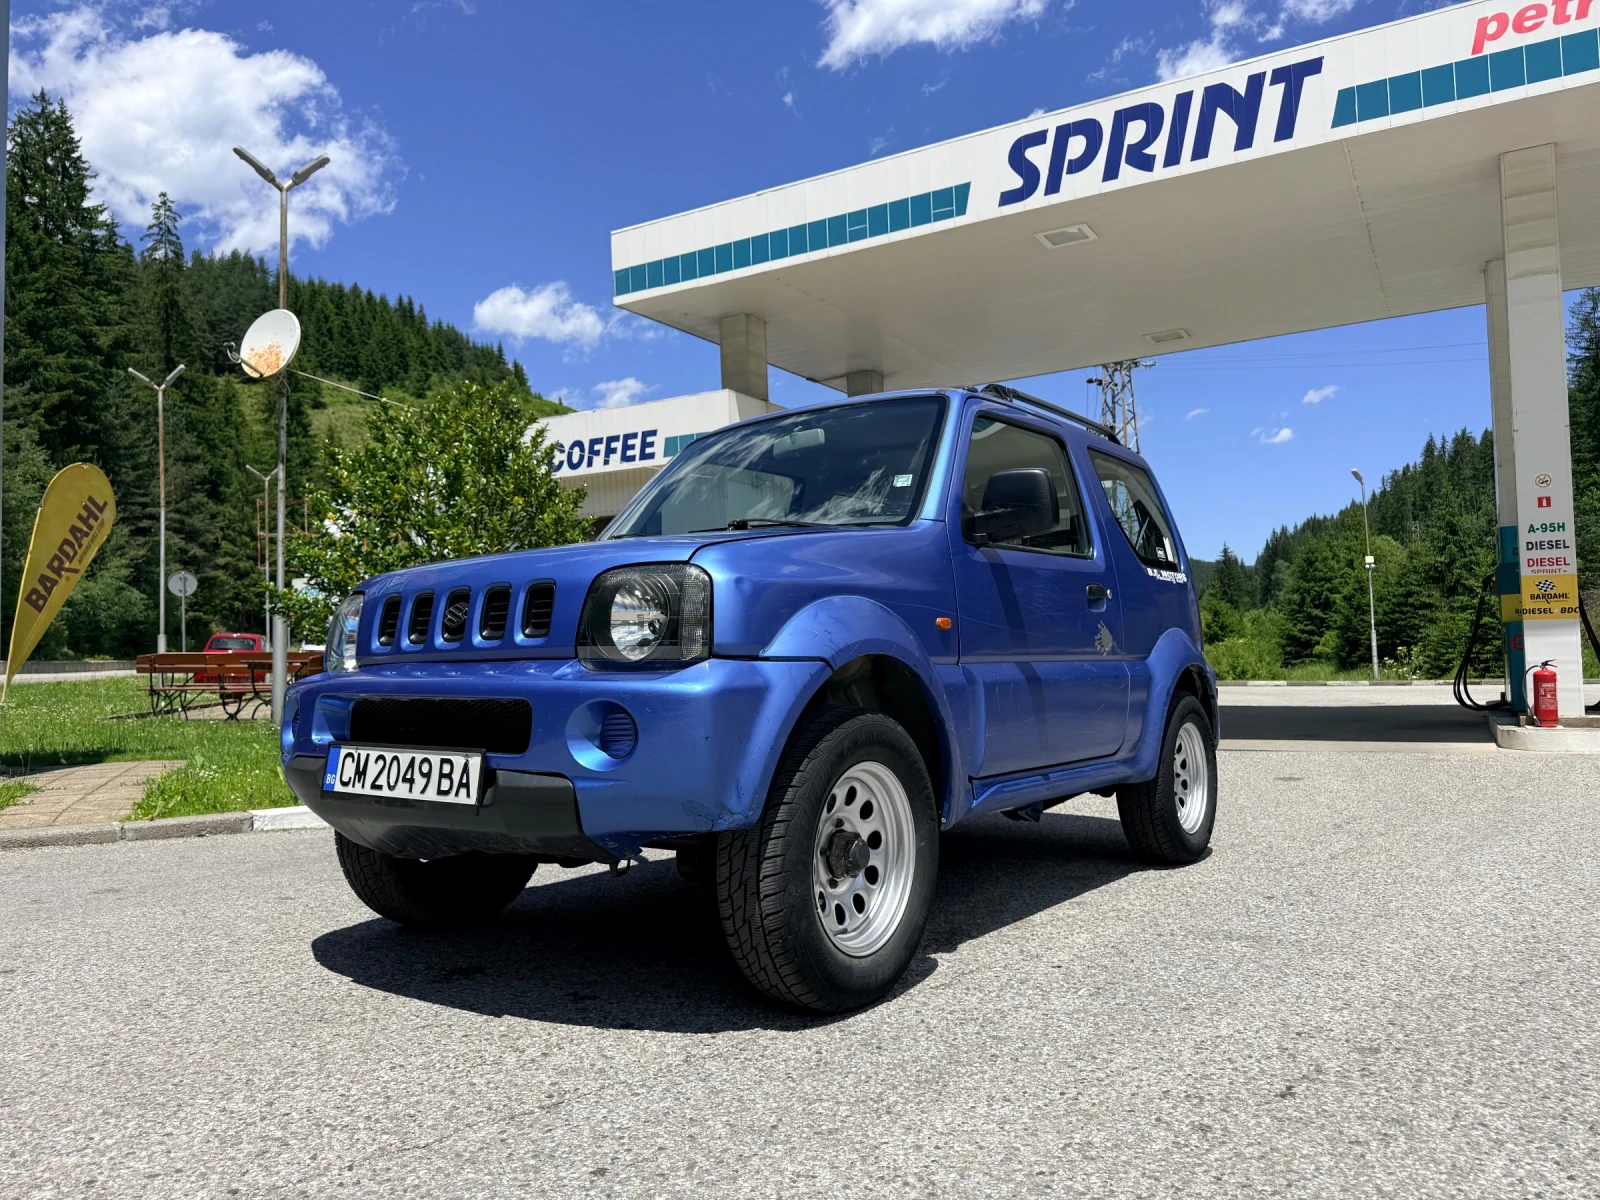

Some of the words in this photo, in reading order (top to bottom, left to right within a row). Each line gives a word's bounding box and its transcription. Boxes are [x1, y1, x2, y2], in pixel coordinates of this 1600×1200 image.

[998, 56, 1324, 207] SPRINT
[1527, 522, 1566, 534] A-95H
[1526, 540, 1570, 551] DIESEL
[24, 495, 108, 614] BARDAHL
[1527, 557, 1571, 568] DIESEL
[1530, 592, 1570, 601] BARDAHL
[1522, 607, 1554, 615] DIESEL
[326, 773, 336, 785] BG
